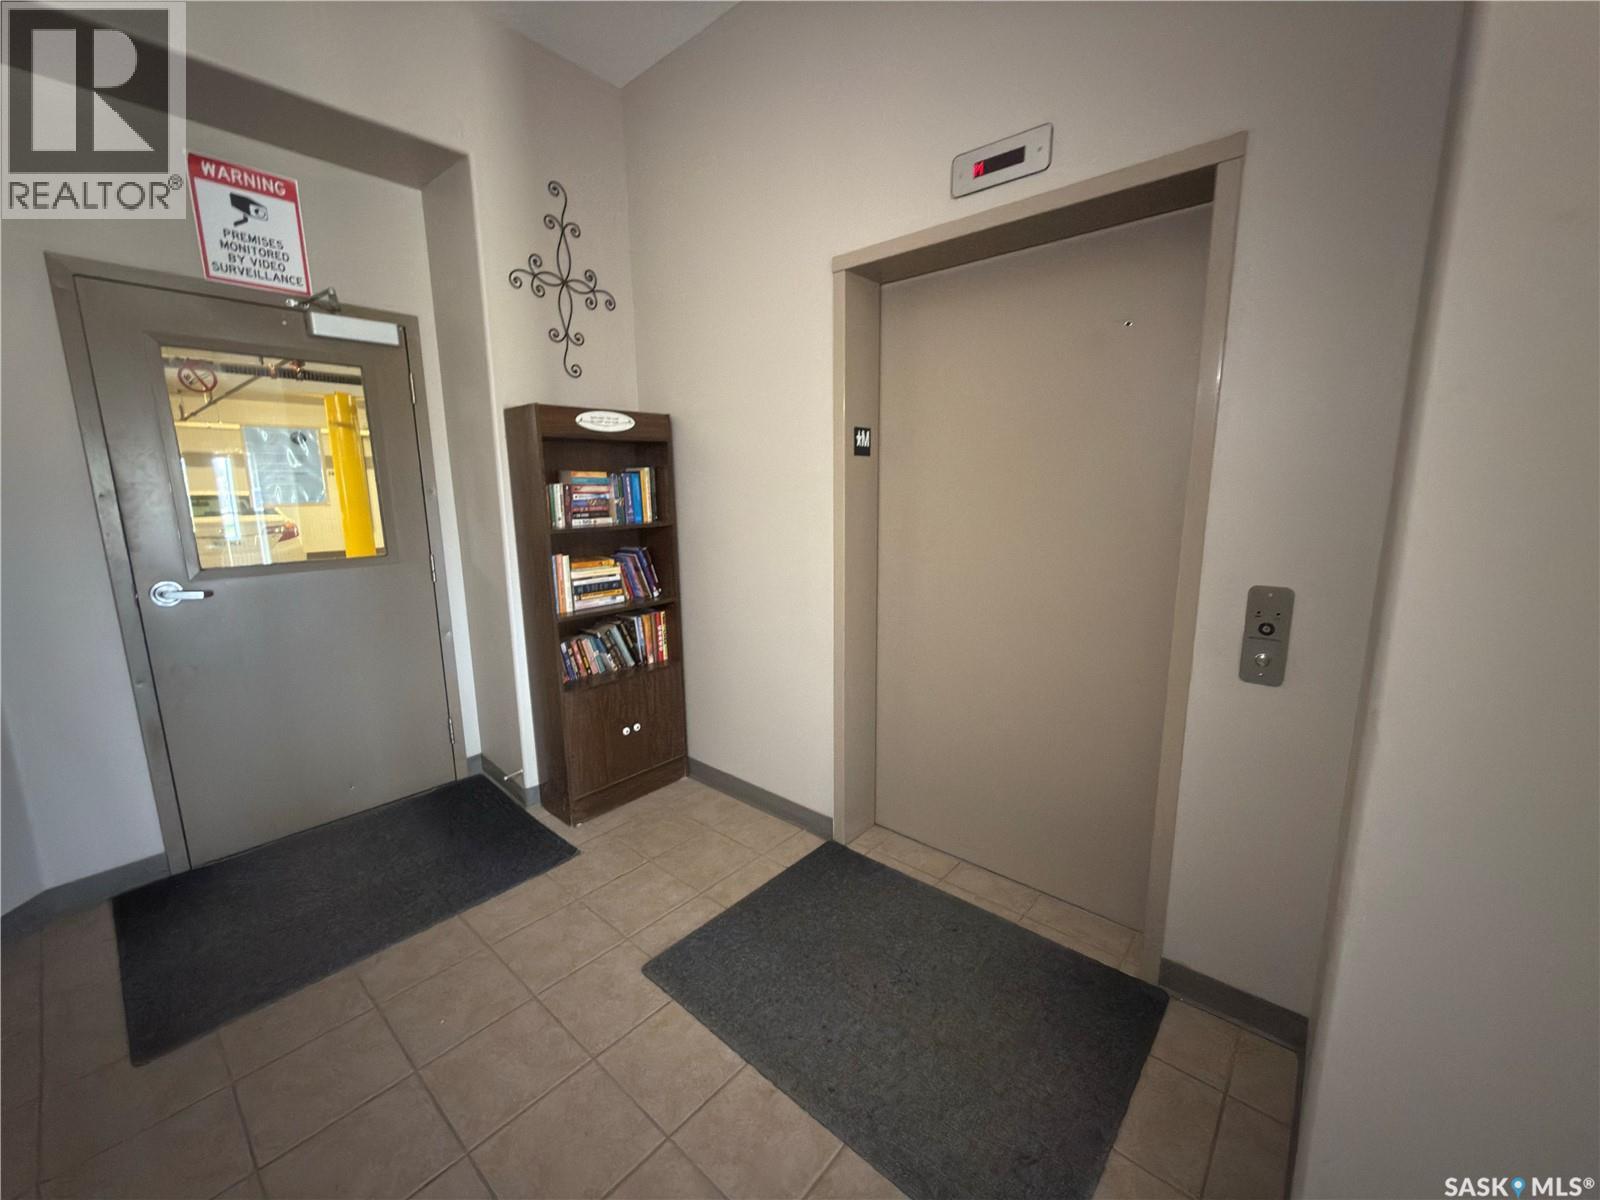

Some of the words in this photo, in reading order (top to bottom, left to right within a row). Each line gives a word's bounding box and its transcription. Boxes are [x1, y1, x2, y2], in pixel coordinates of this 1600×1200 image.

[201, 159, 287, 197] WARNING
[223, 227, 284, 250] PREMISES
[219, 239, 290, 263] MONITORED
[228, 252, 245, 265] BY
[250, 256, 286, 273] VIDEO
[211, 260, 304, 287] SURVEILLANCE
